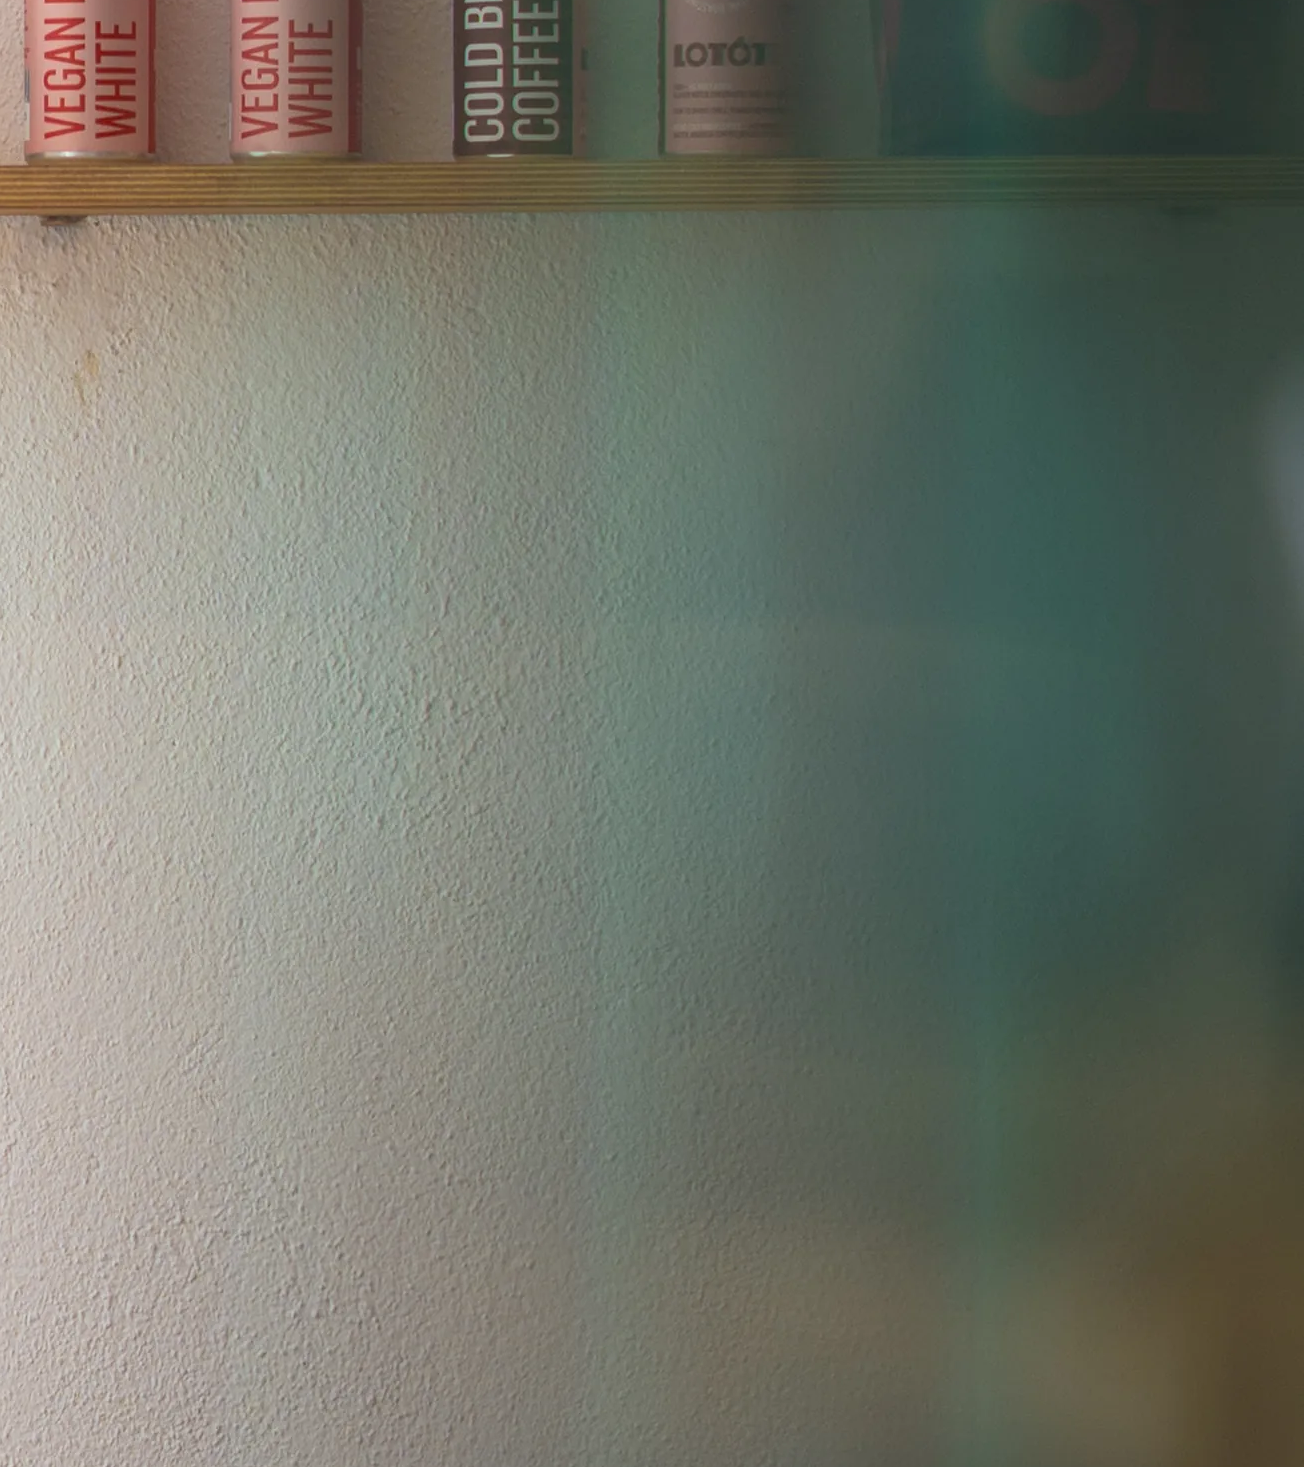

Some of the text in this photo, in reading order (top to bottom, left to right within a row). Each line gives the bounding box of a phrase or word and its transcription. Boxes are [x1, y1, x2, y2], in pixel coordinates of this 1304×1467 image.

[44, 17, 86, 139] VEGAN
[95, 21, 136, 139] WHITE
[241, 17, 279, 139] VEGAN
[288, 19, 332, 138] WHITE
[464, 43, 504, 143] COLD
[512, 0, 559, 142] COFFEE
